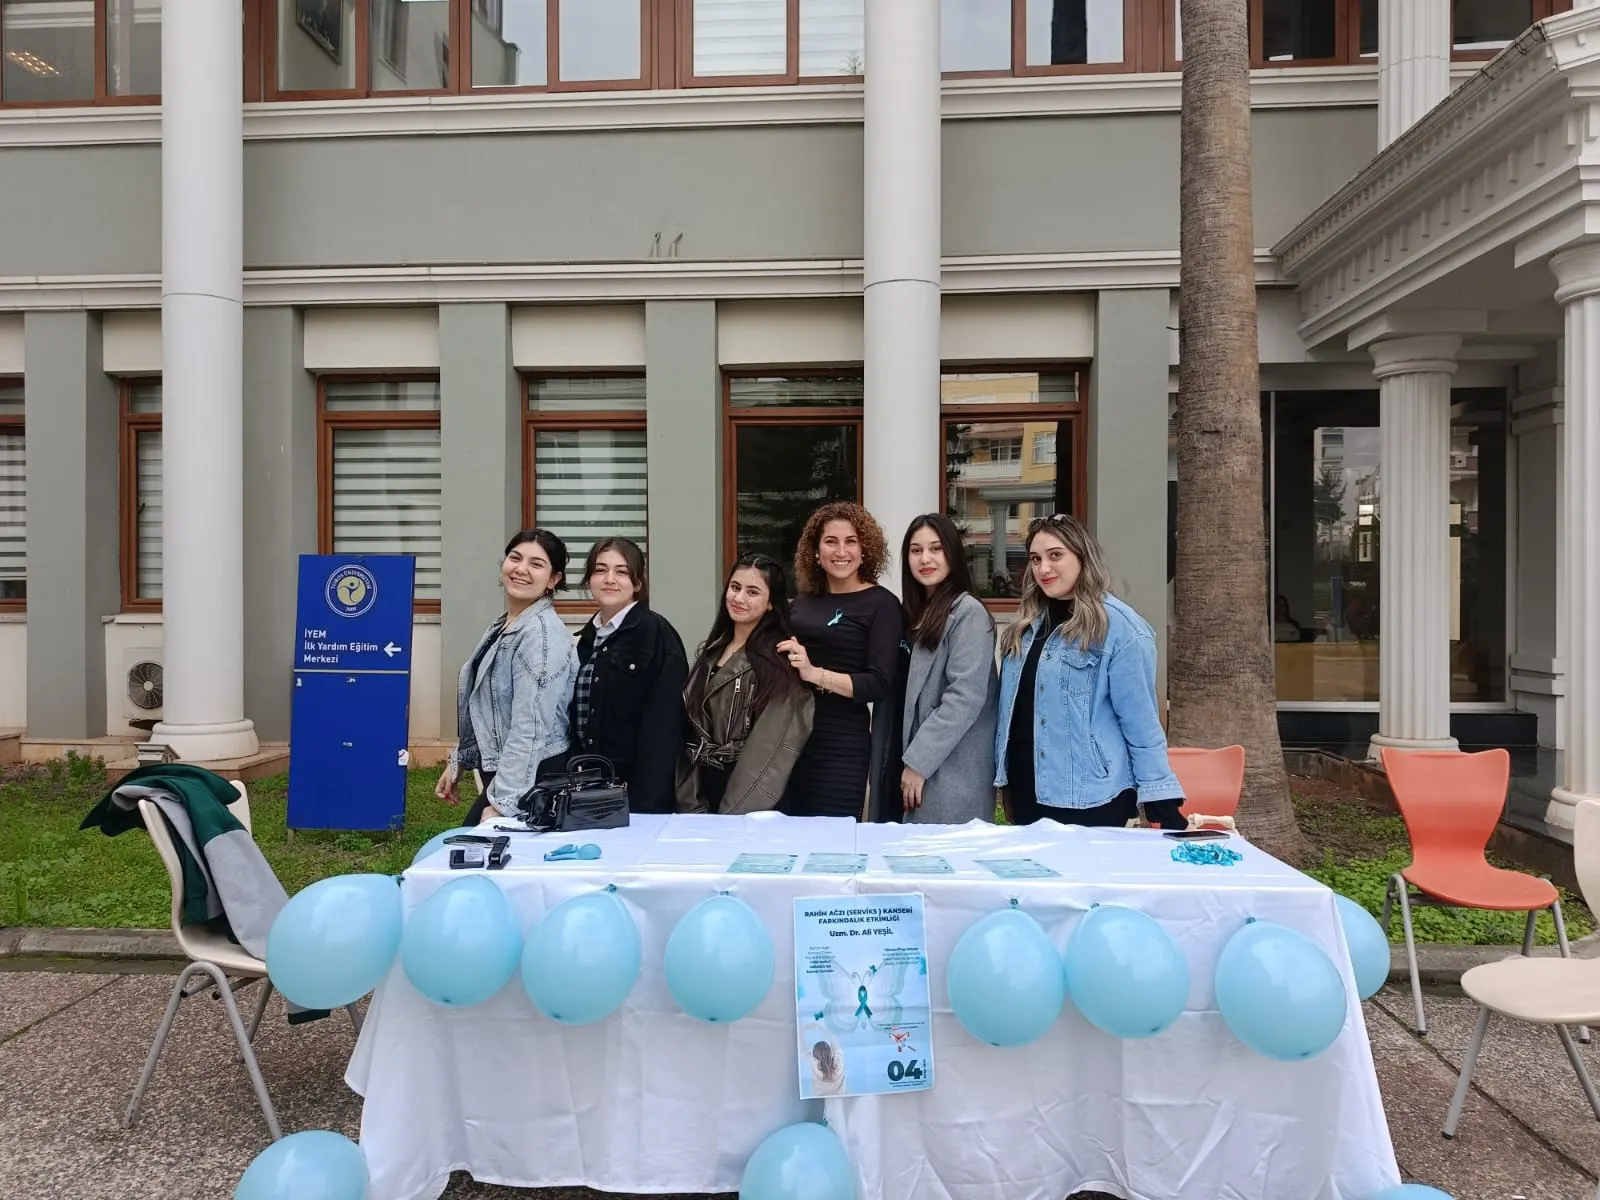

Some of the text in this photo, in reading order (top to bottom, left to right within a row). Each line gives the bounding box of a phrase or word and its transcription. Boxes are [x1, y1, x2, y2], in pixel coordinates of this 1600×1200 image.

[304, 628, 326, 639] İYEM
[304, 640, 378, 653] İlk Yardım Eğitim
[303, 654, 339, 664] Merkezi
[804, 909, 828, 917] RAHİM
[883, 906, 913, 914] KANSERİ
[818, 914, 900, 925] FARKINDALIK ETKİNLİĞİ
[862, 928, 872, 936] Ali
[872, 926, 894, 936] YEŞİL
[887, 1059, 923, 1082] 04
